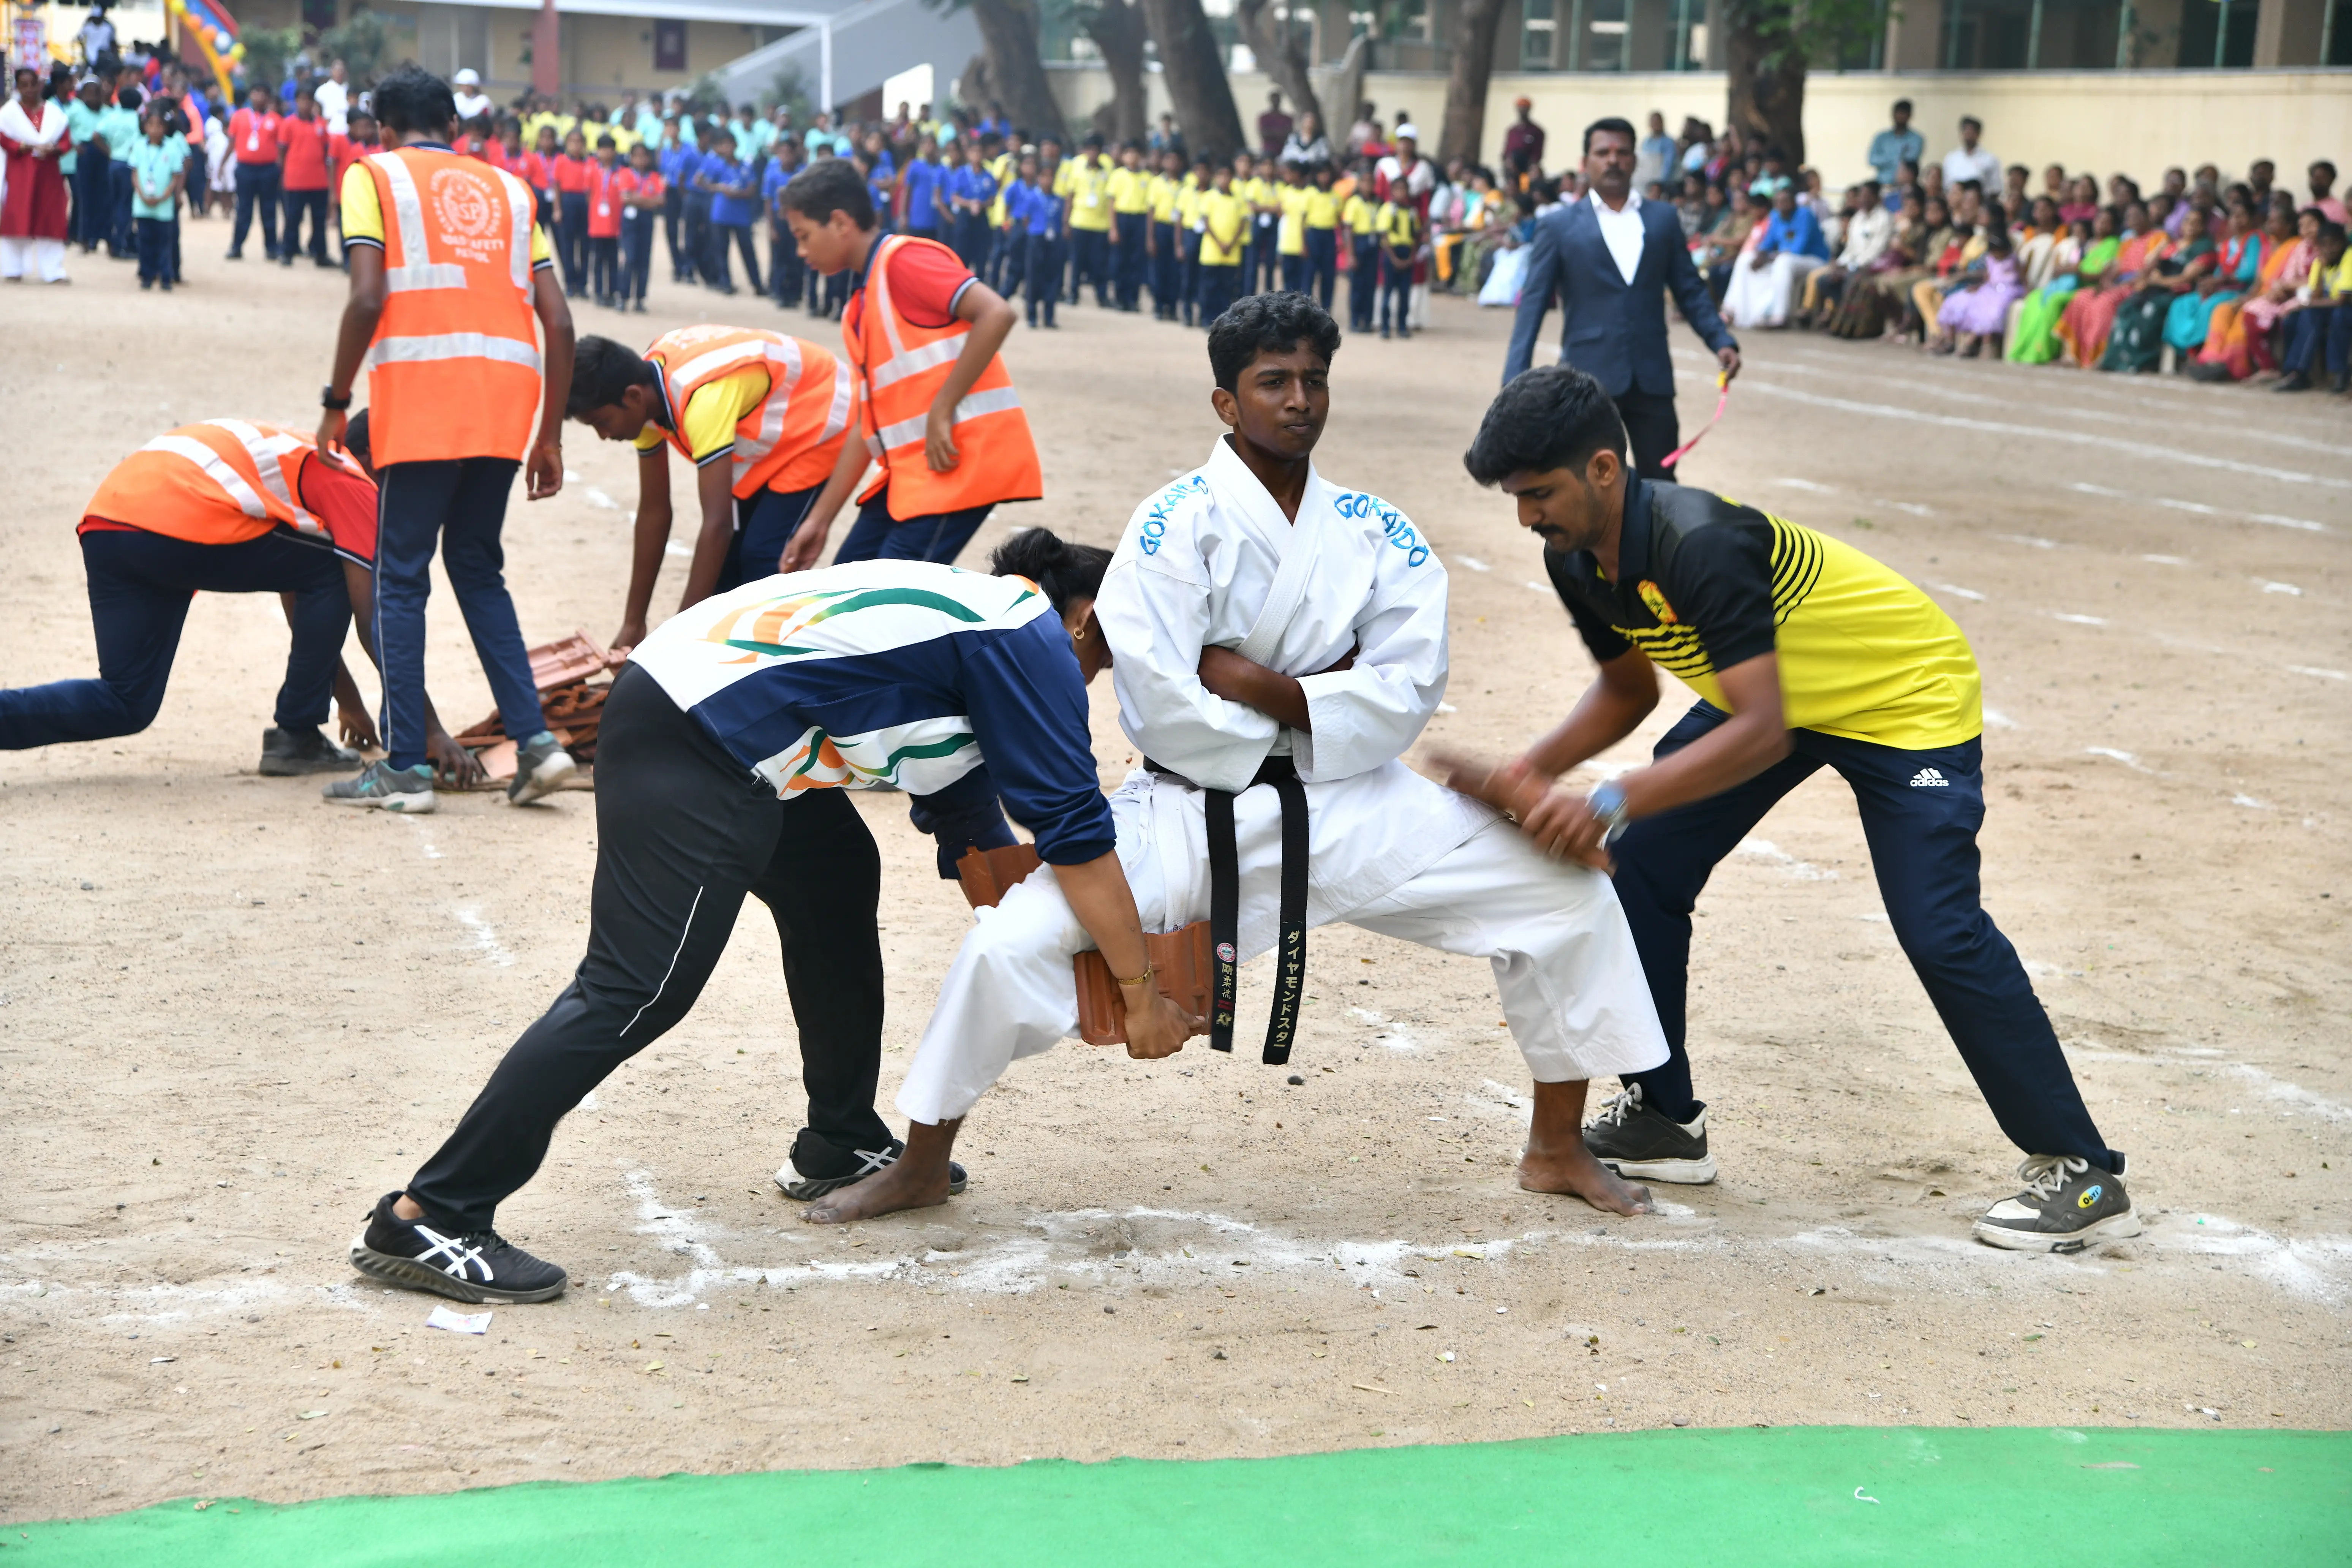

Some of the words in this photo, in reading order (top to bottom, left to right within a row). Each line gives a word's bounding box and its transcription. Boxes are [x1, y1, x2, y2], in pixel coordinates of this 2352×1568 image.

[1140, 475, 1208, 556] GOKAIDO
[1334, 493, 1429, 568] GOKAIDO
[1910, 778, 1949, 787] adidas
[1273, 930, 1300, 1048] ダイヤモンドスター
